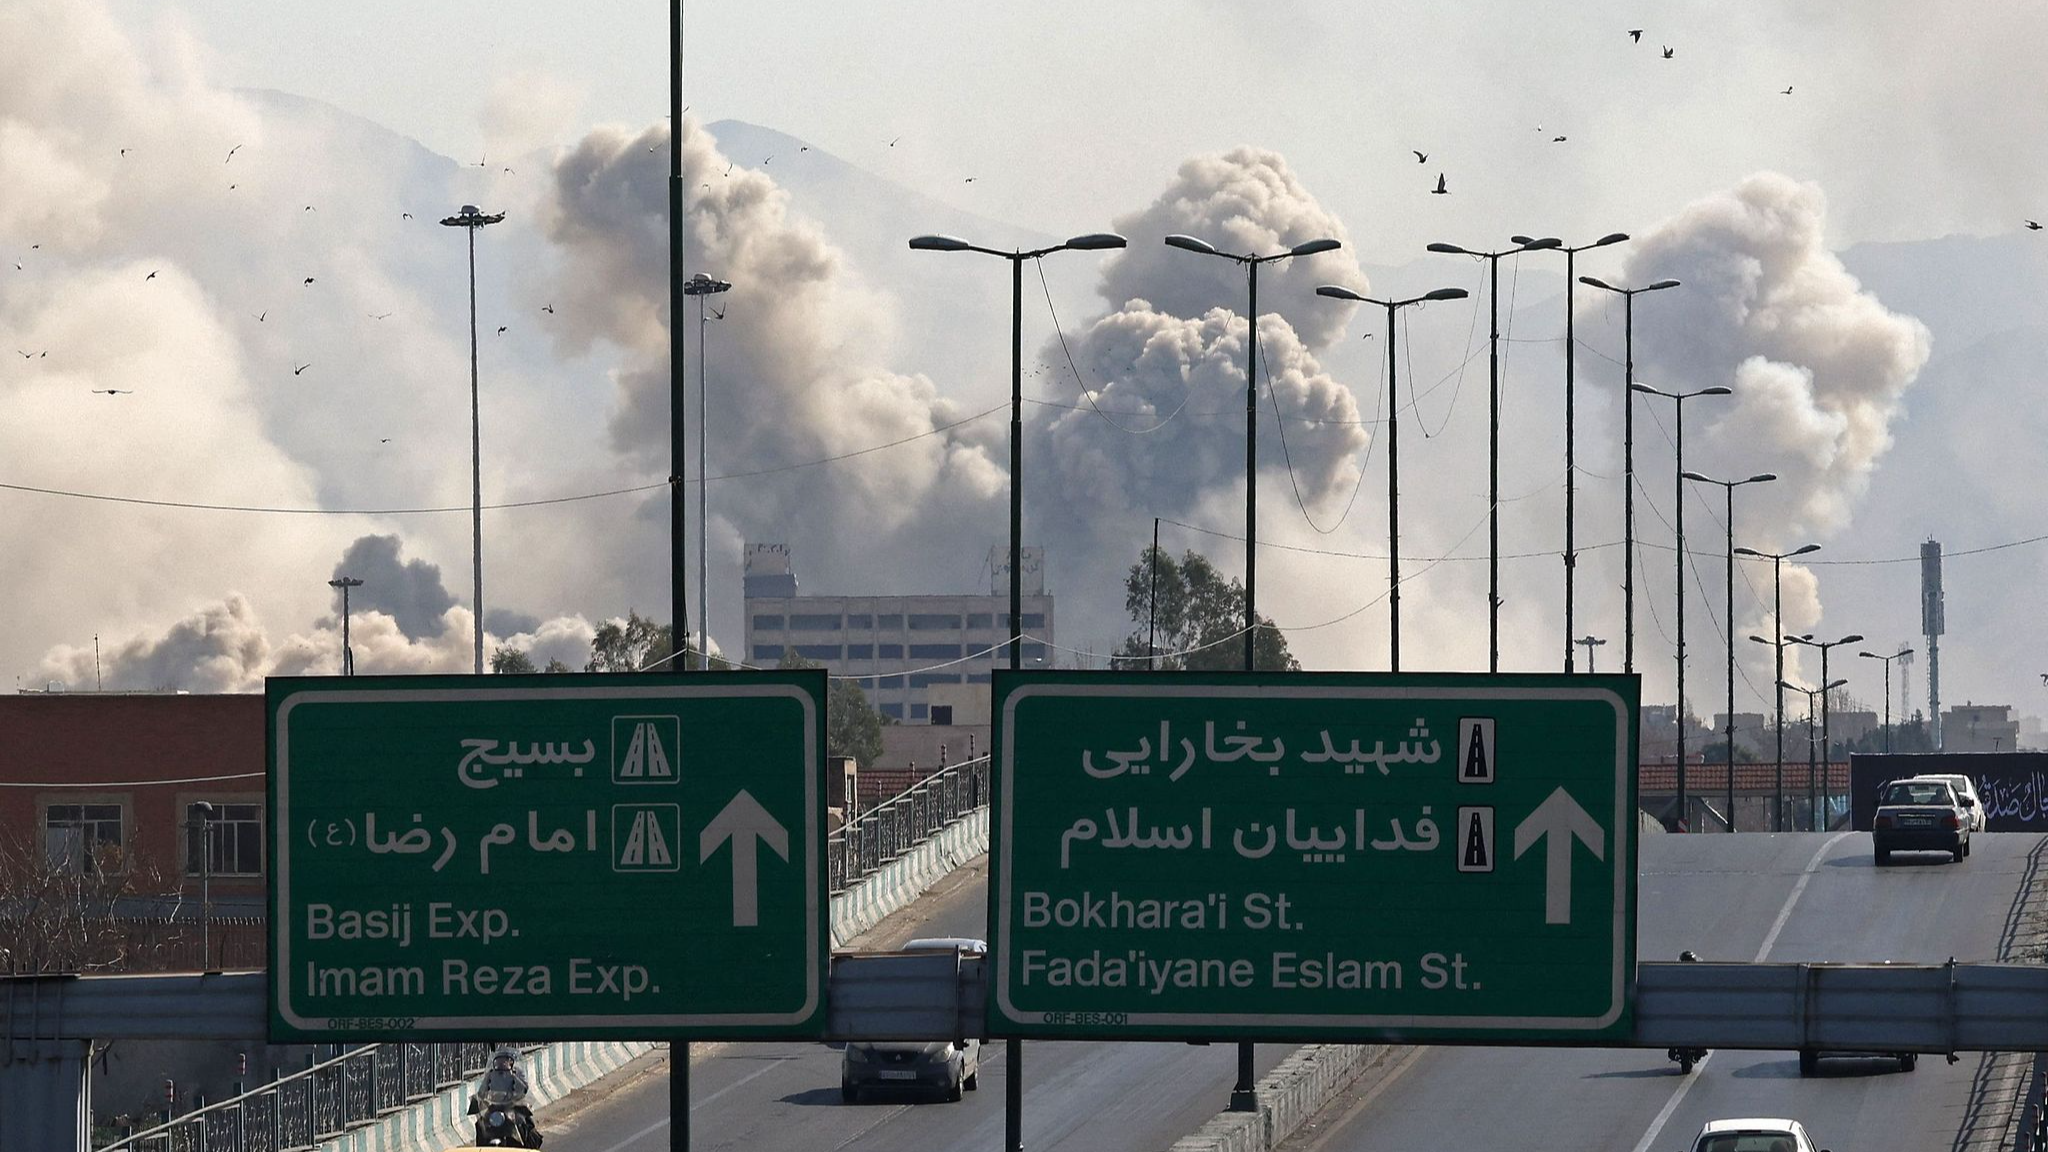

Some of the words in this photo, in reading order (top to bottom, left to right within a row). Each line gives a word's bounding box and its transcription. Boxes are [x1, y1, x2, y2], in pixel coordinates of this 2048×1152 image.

[458, 737, 596, 788] بسیج
[1083, 721, 1284, 781] بخارایی
[1301, 718, 1441, 775] شهید
[366, 812, 457, 871] رضا
[481, 809, 597, 873] امام
[1061, 806, 1212, 868] اسلام
[1234, 805, 1440, 862] فداییان
[307, 903, 410, 946] Basij
[429, 902, 519, 945] Exp.
[1024, 891, 1226, 928] Bokhara'i
[1243, 892, 1303, 930] St.
[308, 961, 424, 996] Imam
[442, 959, 551, 995] Reza
[569, 958, 660, 1000] Exp.
[1022, 949, 1254, 995] Fada'iyane
[1272, 952, 1402, 989] Eslam
[1420, 952, 1481, 990] St.
